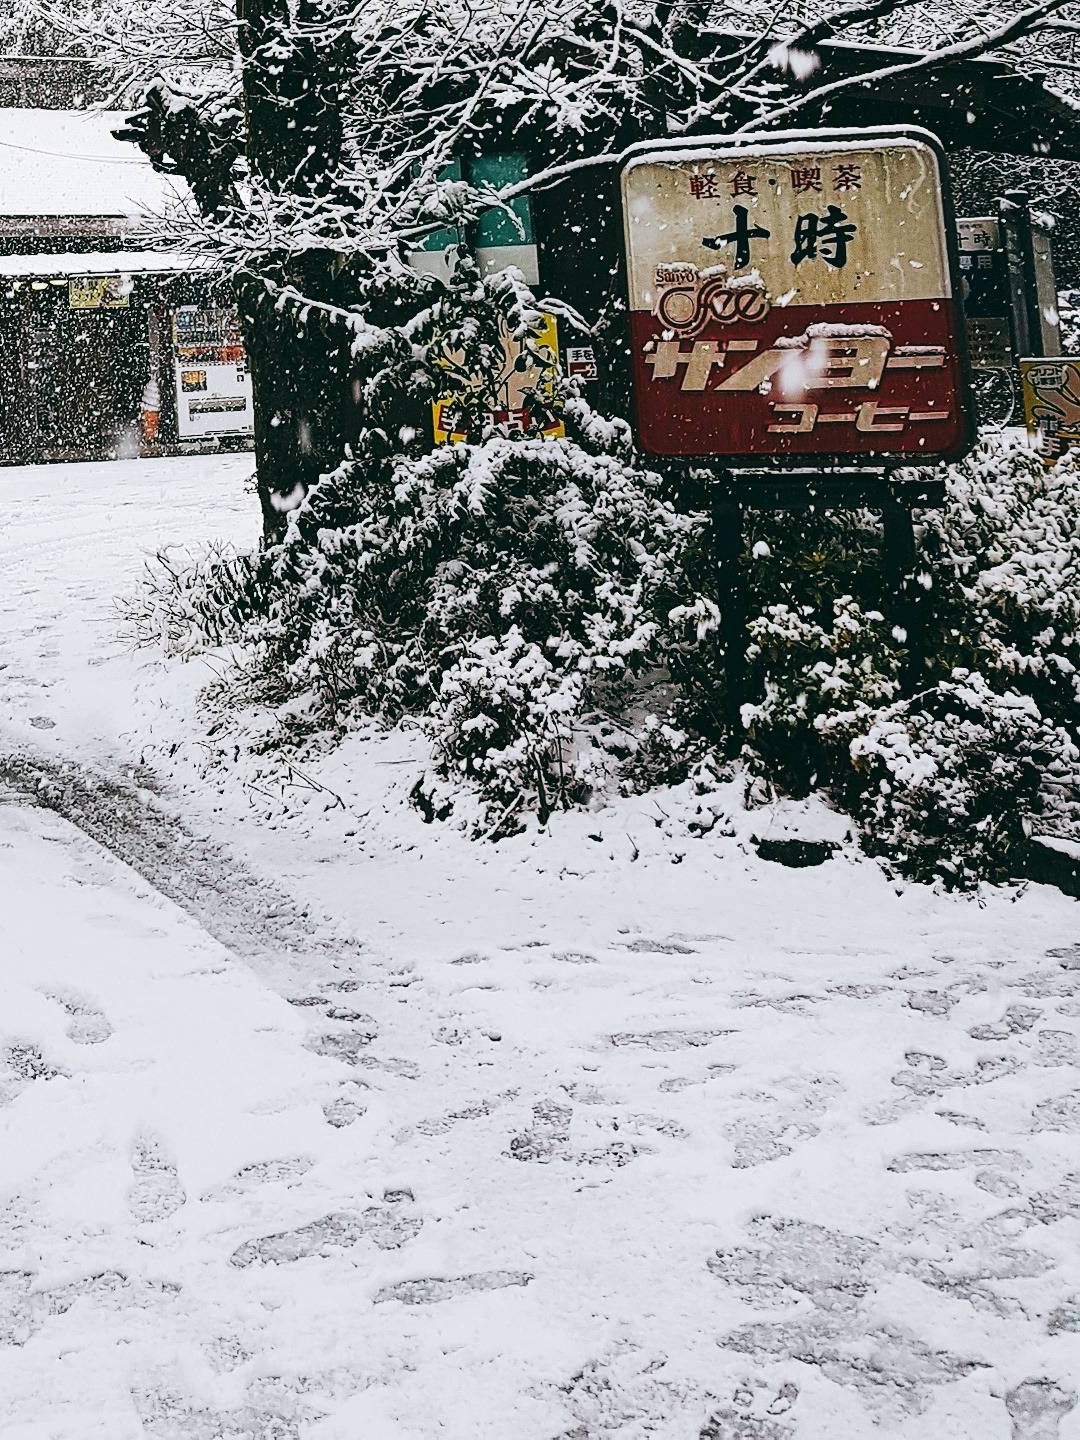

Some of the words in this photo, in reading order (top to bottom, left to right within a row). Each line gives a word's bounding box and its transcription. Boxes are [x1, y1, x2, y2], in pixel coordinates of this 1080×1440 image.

[689, 165, 862, 200] 軽食・喫茶
[702, 205, 858, 271] 十時
[645, 336, 945, 392] サンヨー
[767, 401, 950, 433] コーヒー
